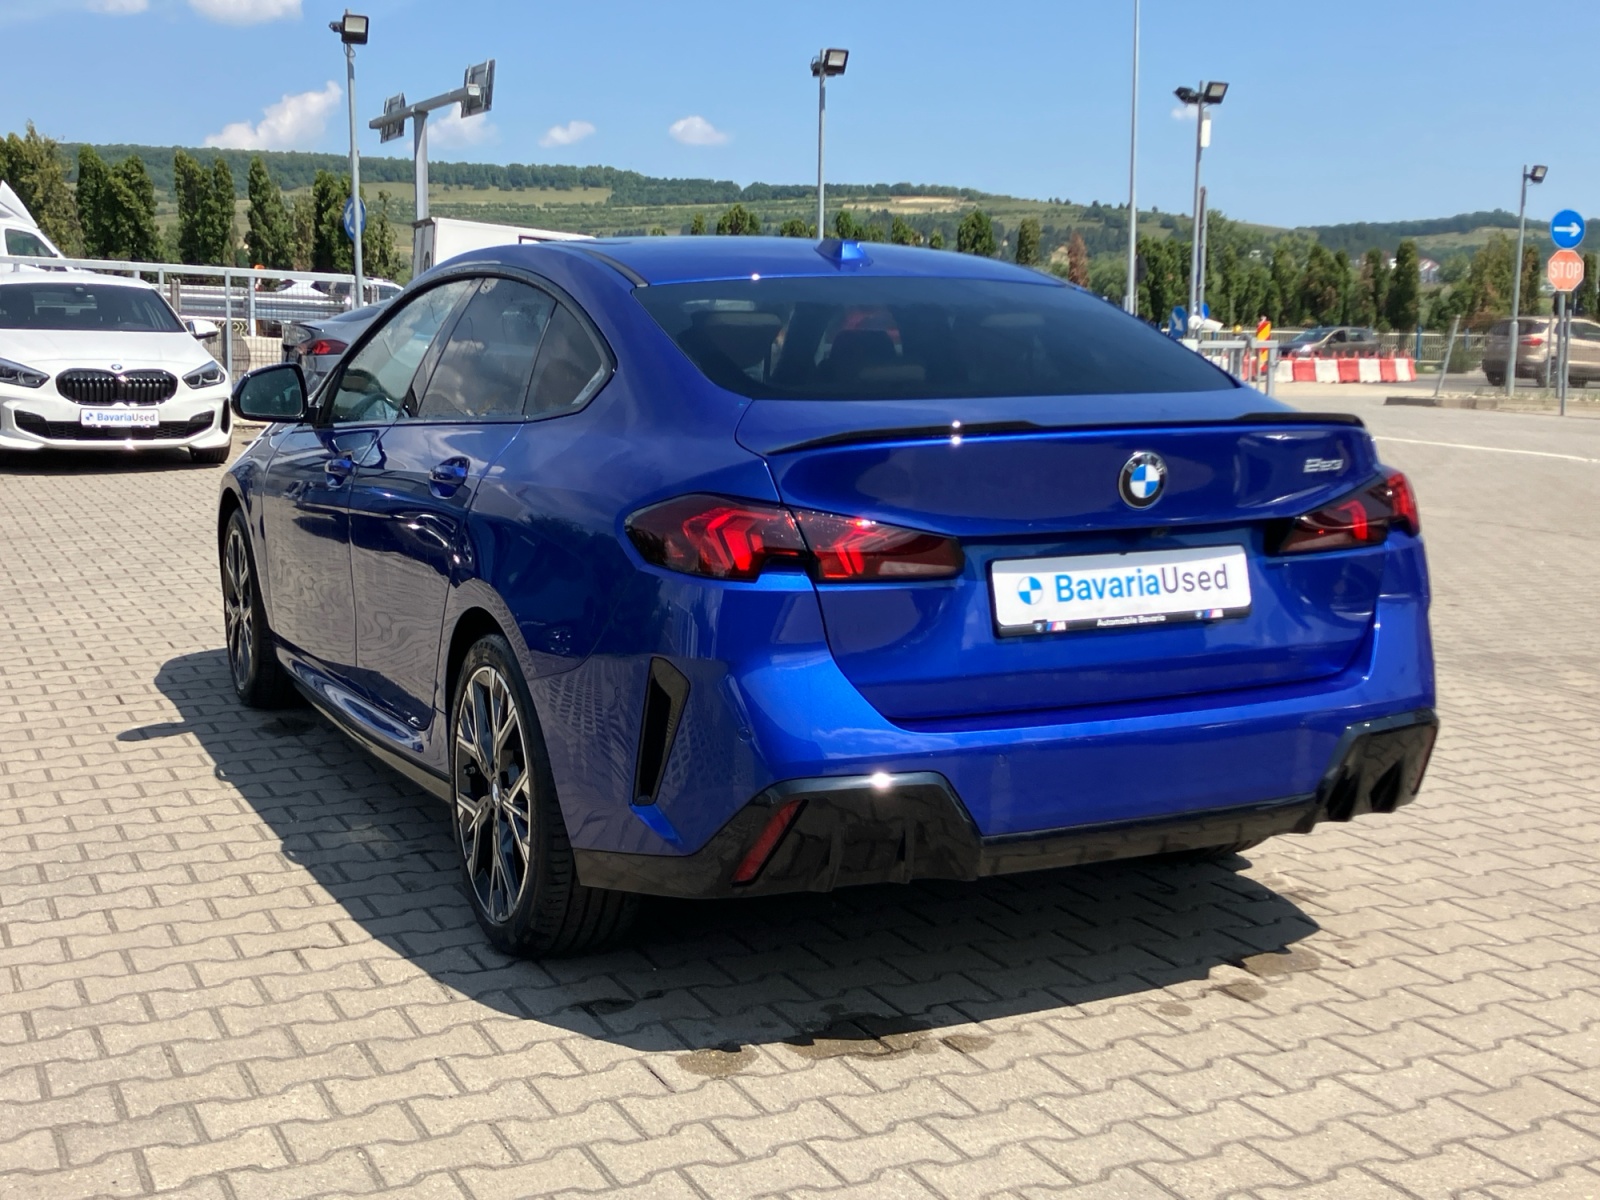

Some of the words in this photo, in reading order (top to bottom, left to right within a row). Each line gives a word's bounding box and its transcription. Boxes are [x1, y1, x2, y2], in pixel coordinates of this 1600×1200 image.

[1551, 261, 1582, 279] STOP
[97, 413, 155, 422] BavariaUsed
[1055, 564, 1229, 602] BavariaUsed
